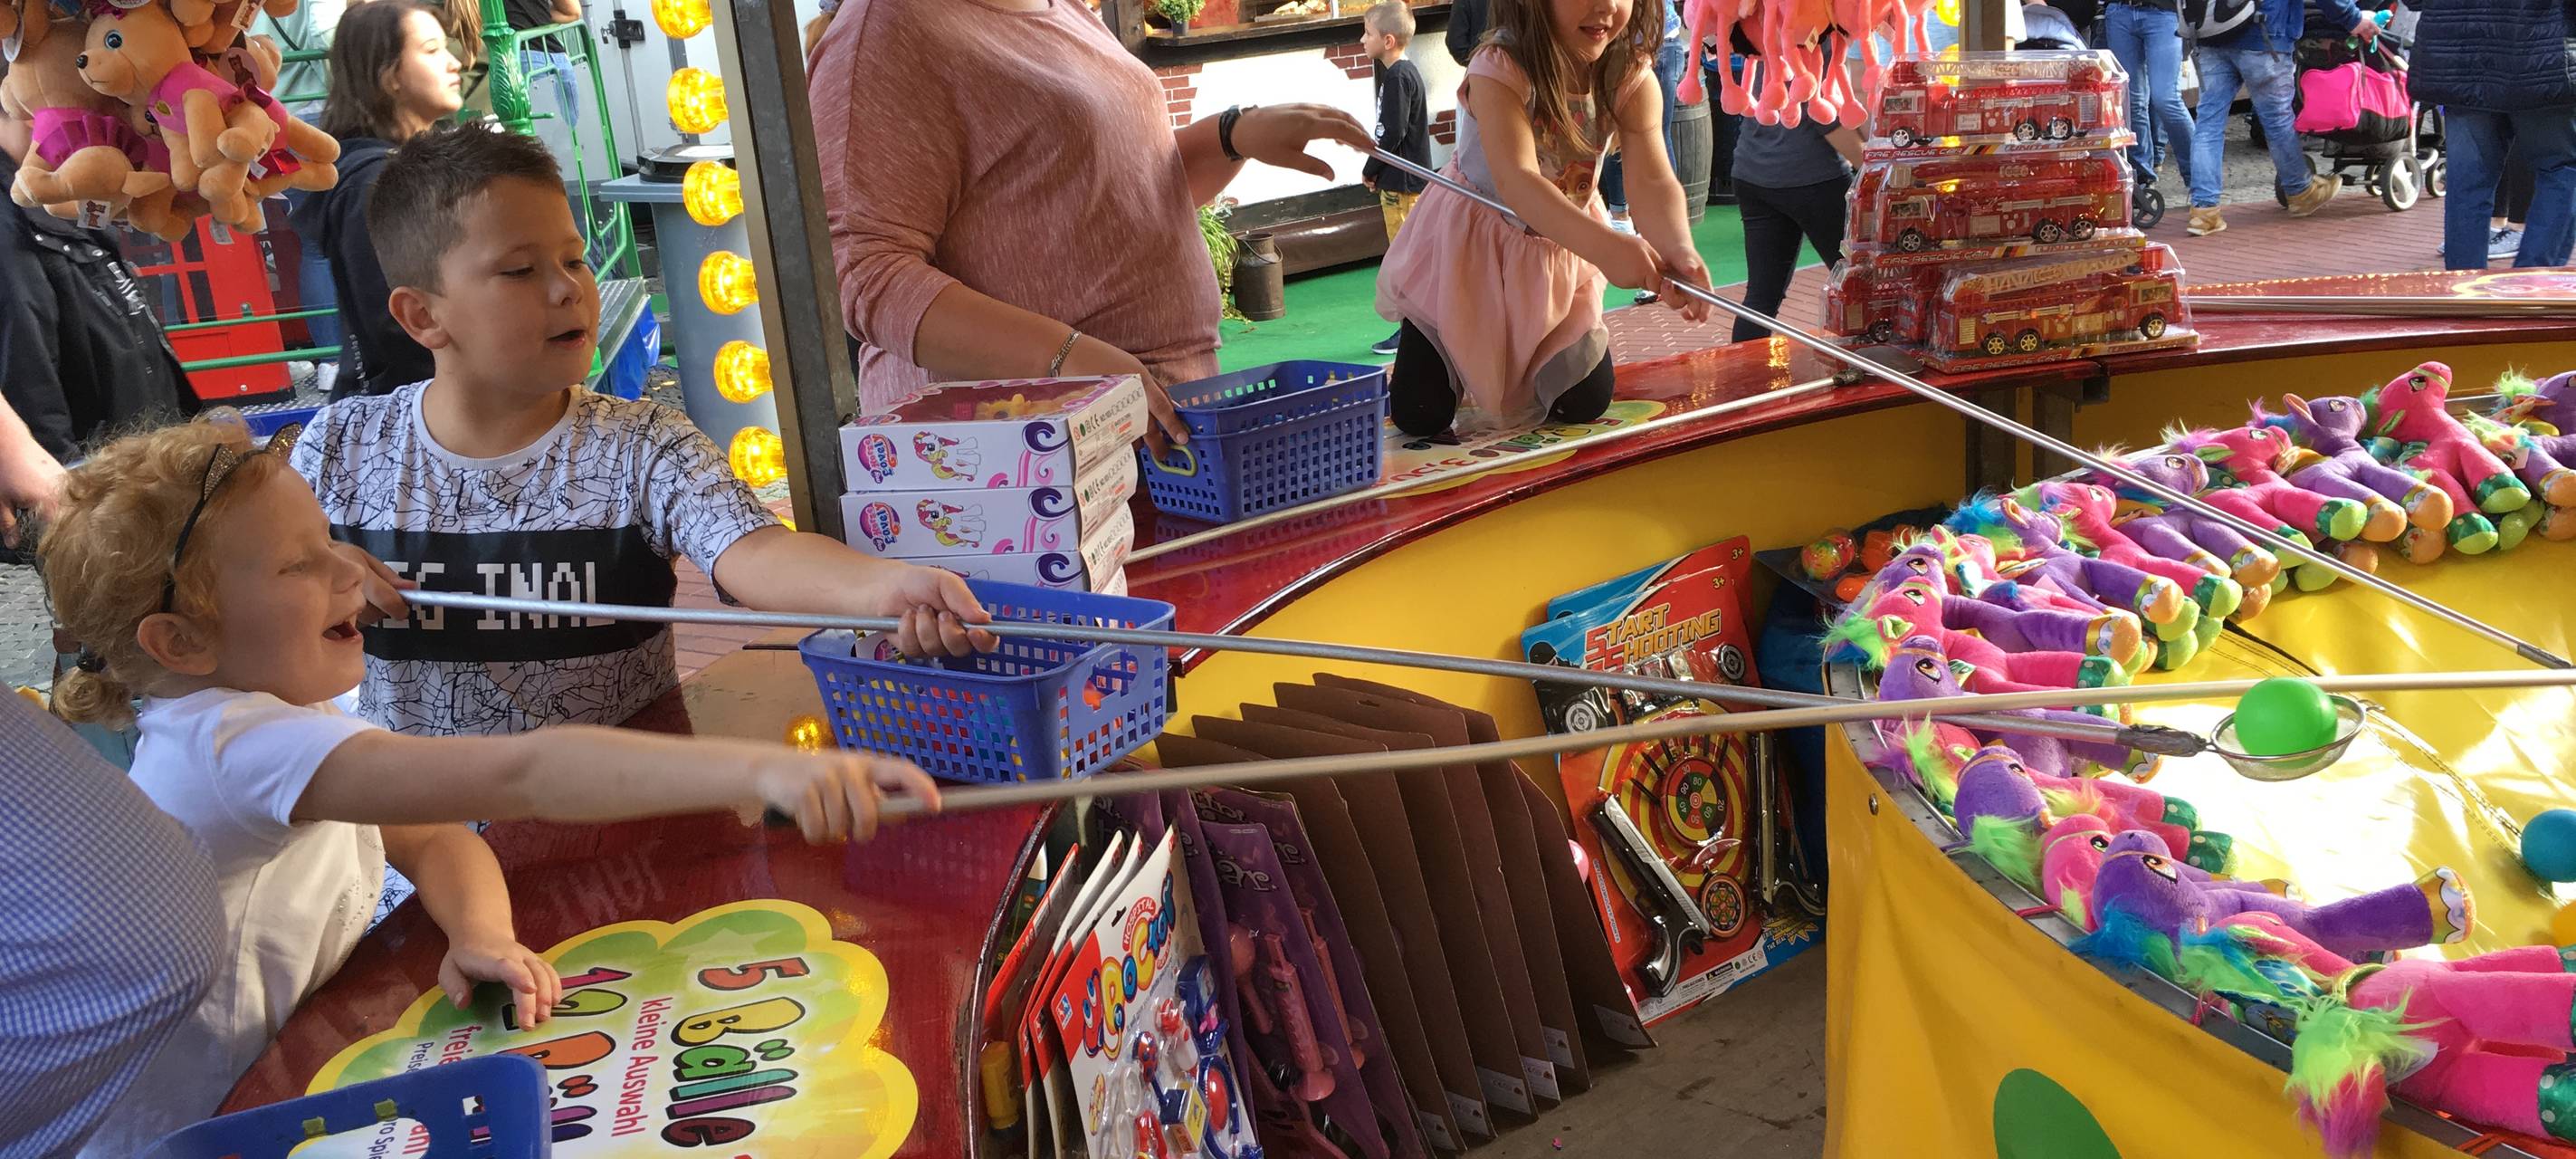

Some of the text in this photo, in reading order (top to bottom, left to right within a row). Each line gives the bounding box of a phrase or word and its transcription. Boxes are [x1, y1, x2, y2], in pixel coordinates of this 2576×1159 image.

[1866, 147, 1962, 159] FIRE RESCUE CAR
[1882, 255, 1910, 265] FIRE
[1913, 253, 1960, 263] RESCUE
[1951, 363, 1980, 372] FIRE
[1983, 359, 2034, 370] RESCUE
[1731, 547, 1745, 560] 3+
[1713, 576, 1726, 589] 3+
[1586, 602, 1670, 664] START
[1604, 608, 1722, 672] SHOOTING
[698, 956, 810, 991] 5
[611, 996, 673, 1137] kleine Auswahl
[661, 996, 806, 1148] Bälle
